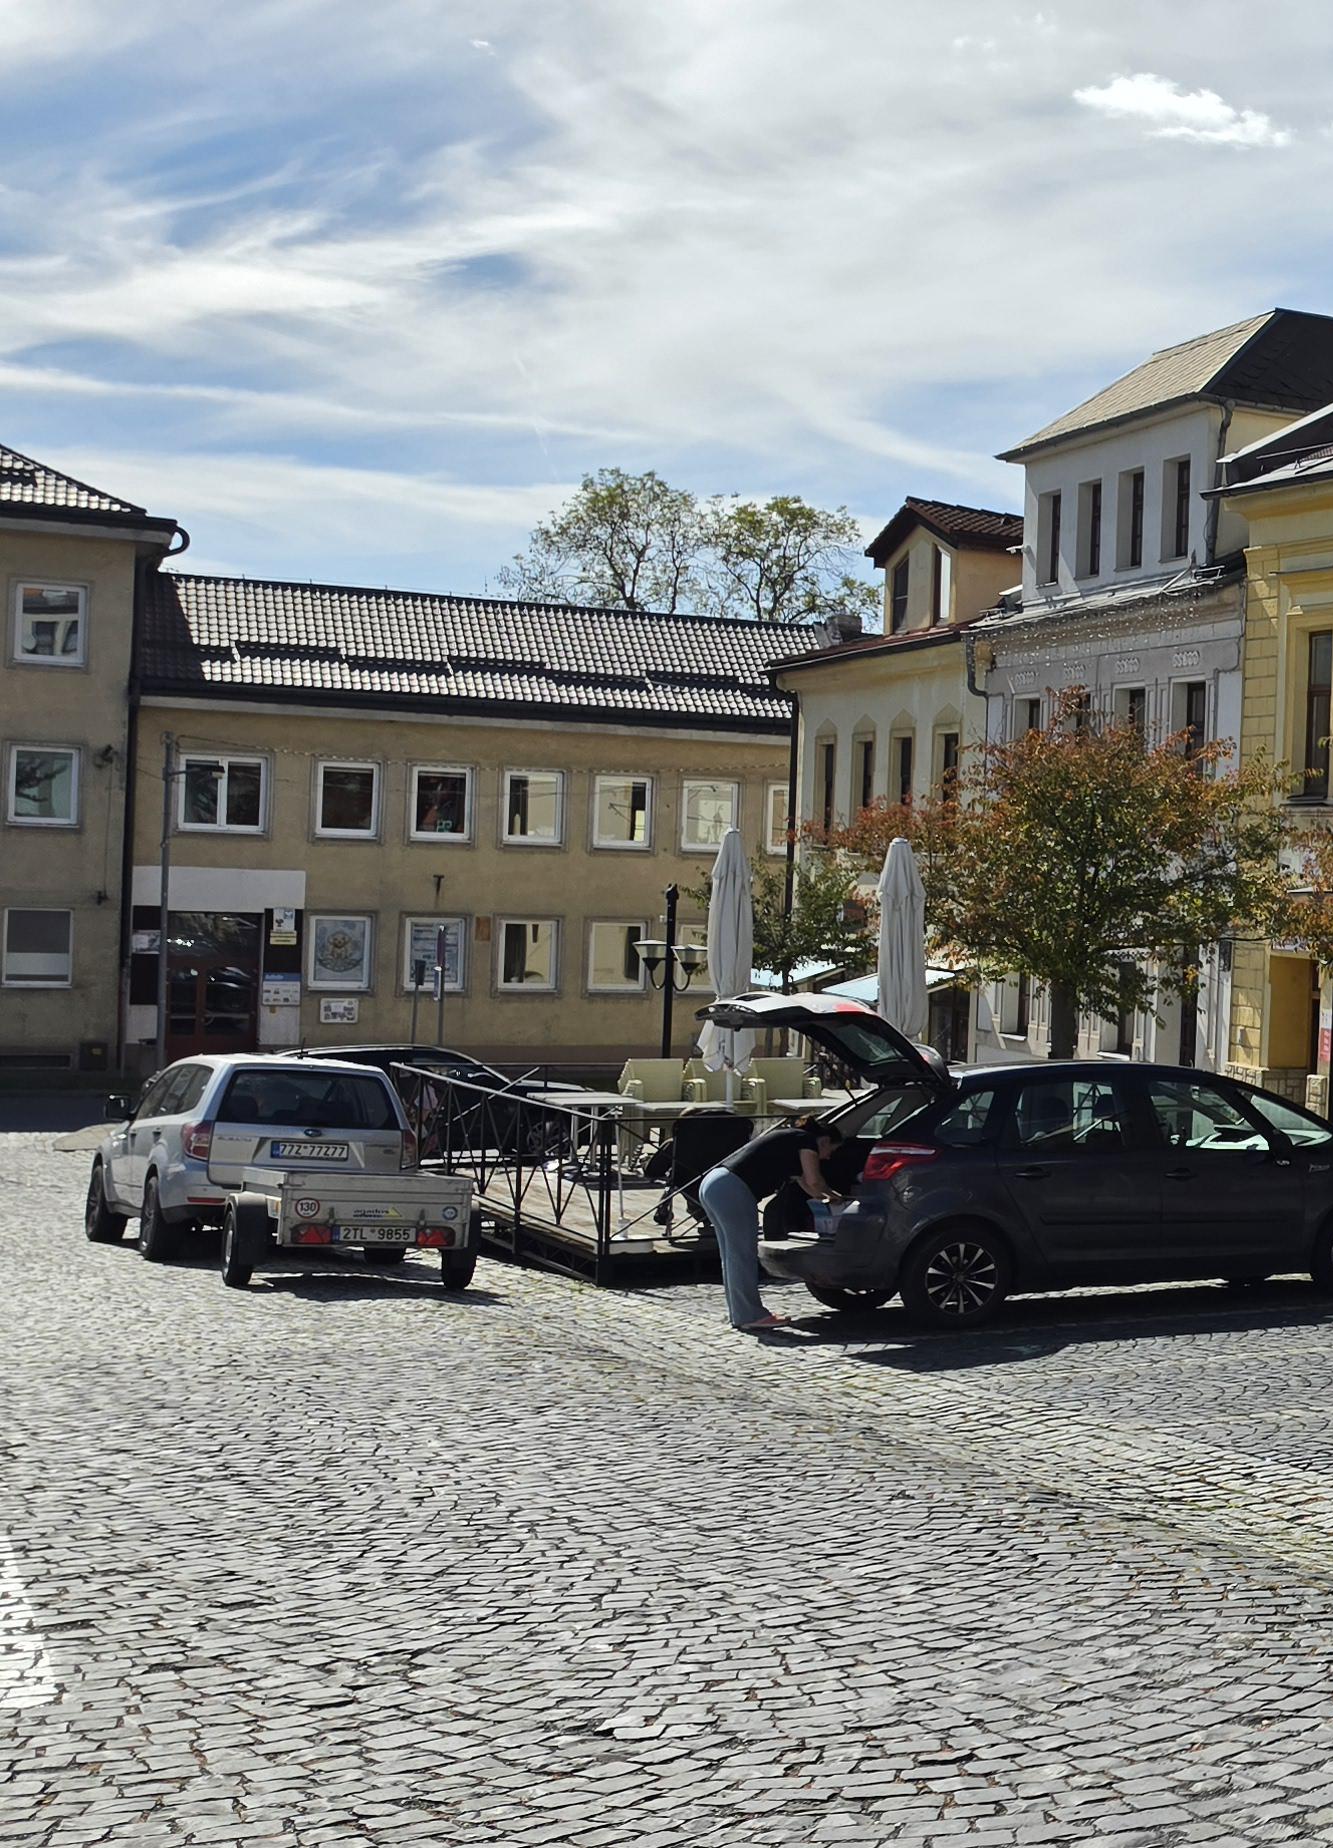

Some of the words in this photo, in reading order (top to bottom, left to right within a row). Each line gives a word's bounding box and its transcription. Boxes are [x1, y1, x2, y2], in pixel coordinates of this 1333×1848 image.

[299, 1201, 317, 1213] 130
[343, 1227, 367, 1240] 2TL
[377, 1228, 411, 1241] 9855
